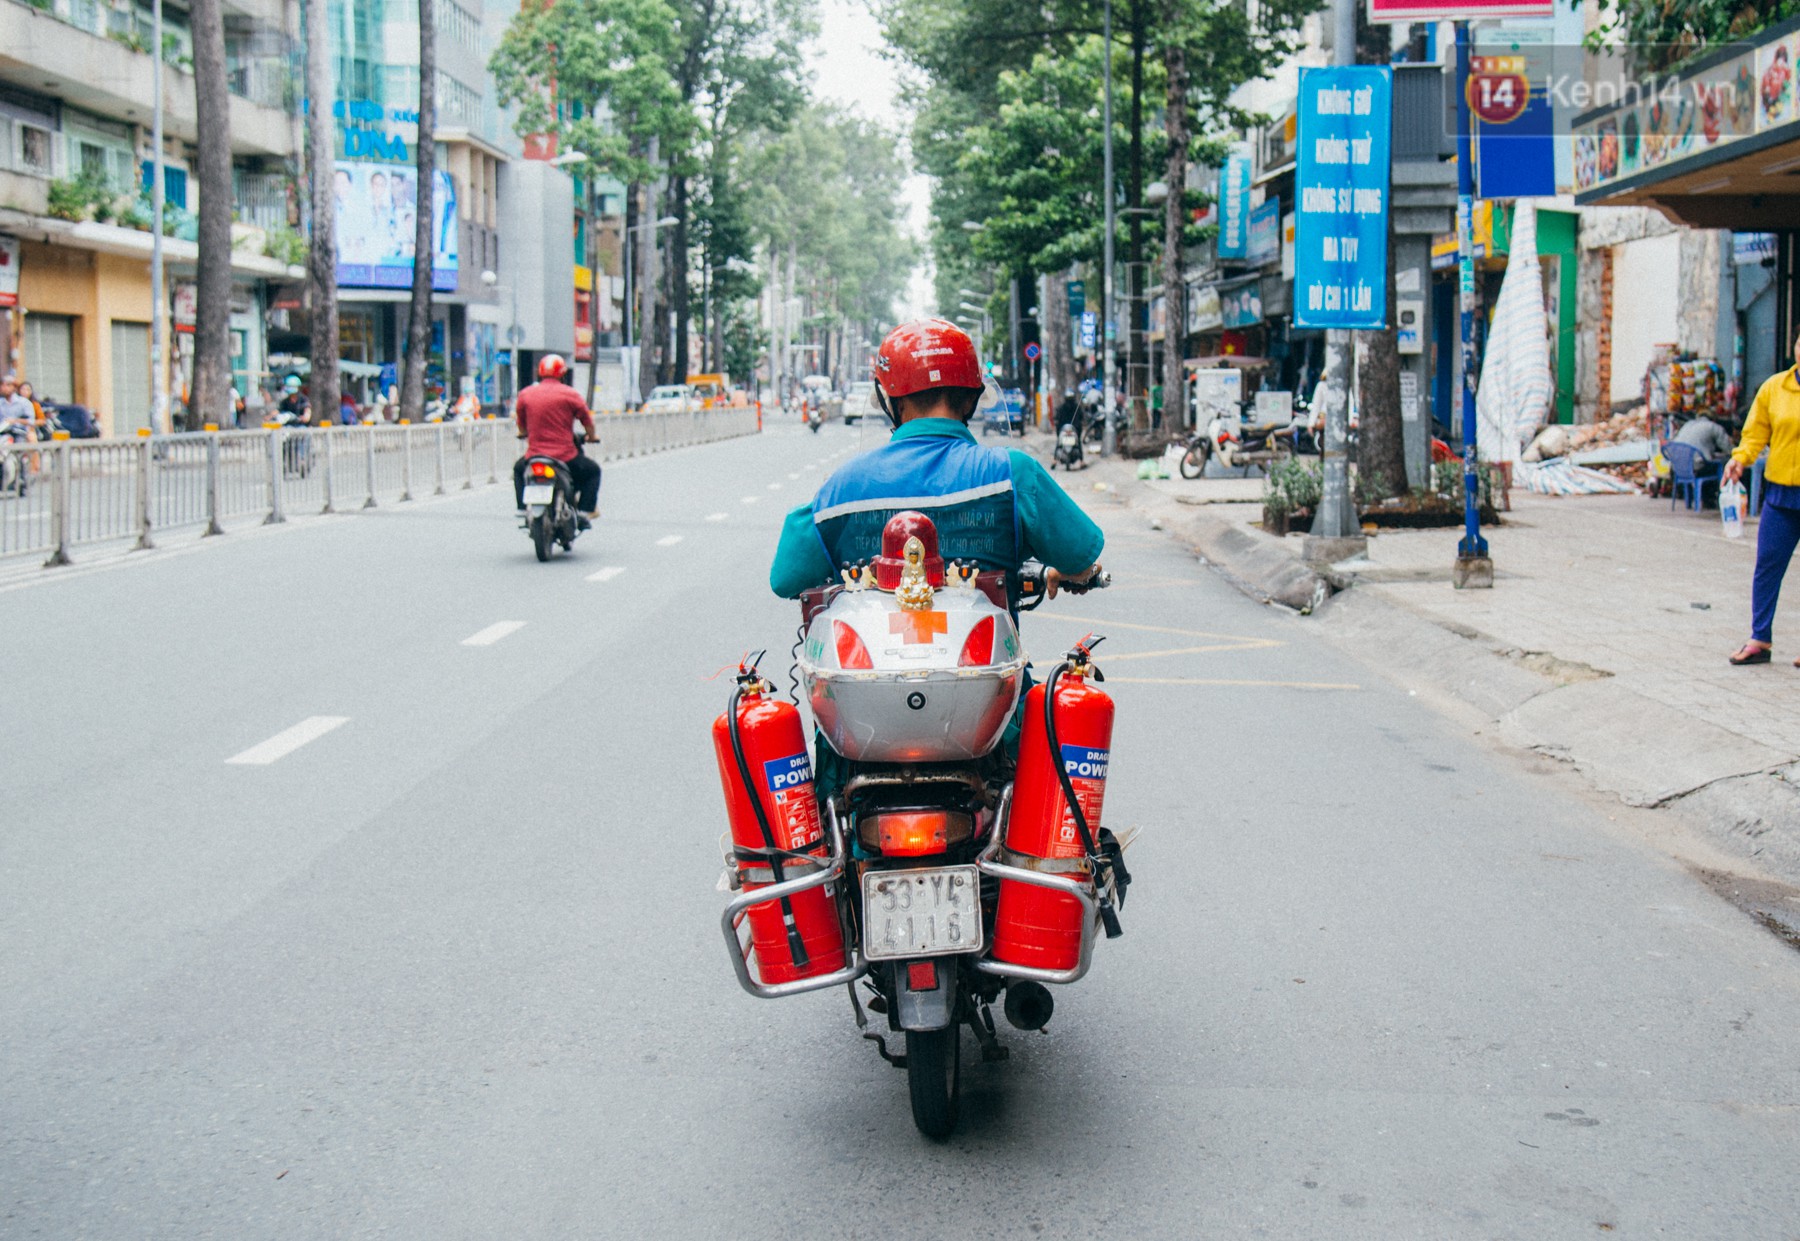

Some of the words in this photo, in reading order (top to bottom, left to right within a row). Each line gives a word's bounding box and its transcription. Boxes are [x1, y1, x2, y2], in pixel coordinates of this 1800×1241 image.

[344, 126, 408, 161] DNA
[1343, 286, 1349, 311] 1
[883, 912, 962, 949] 4116
